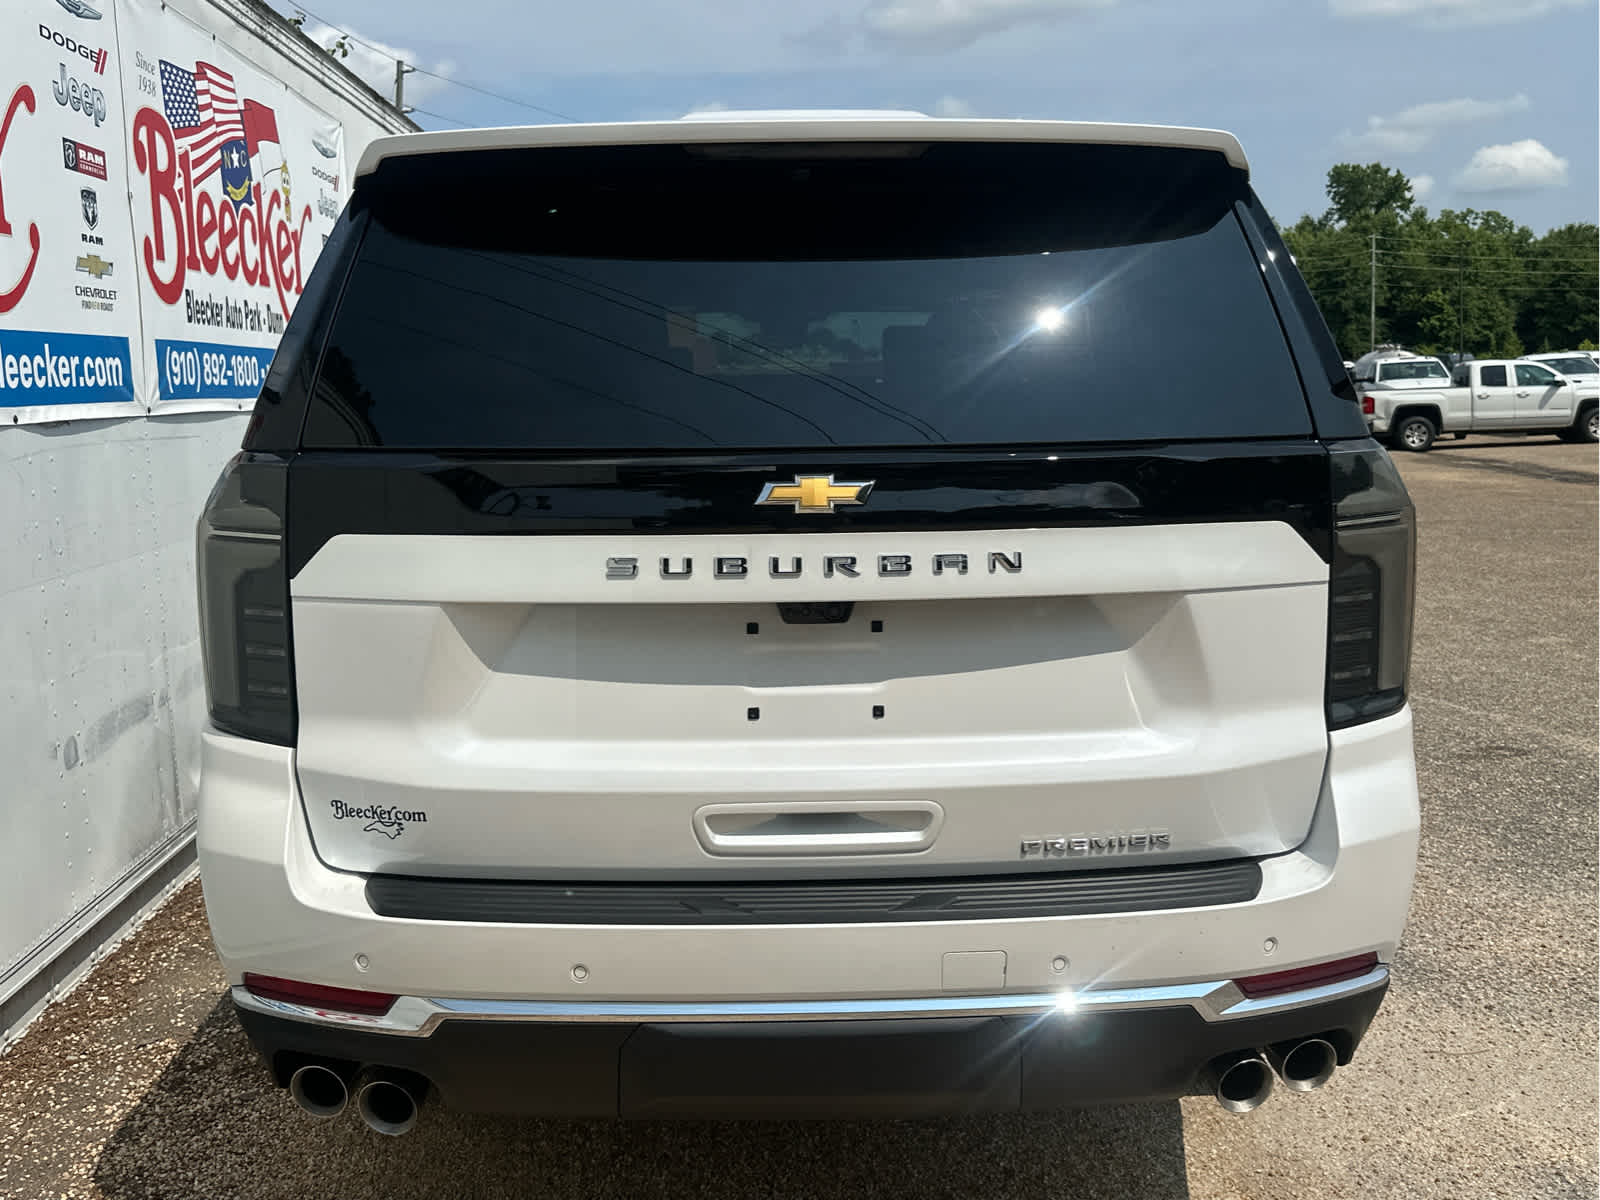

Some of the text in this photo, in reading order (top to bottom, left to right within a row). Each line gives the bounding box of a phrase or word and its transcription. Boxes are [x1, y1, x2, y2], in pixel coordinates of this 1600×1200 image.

[39, 24, 100, 64] DODGE
[136, 51, 156, 75] Since
[52, 62, 106, 127] Jeep
[138, 75, 157, 97] 1938
[79, 149, 104, 166] RAM
[132, 107, 312, 323] Bleecker
[81, 233, 103, 246] RAM
[75, 285, 117, 300] CHEVROLET
[185, 289, 223, 328] Bleecker
[225, 295, 243, 331] Auto
[243, 299, 263, 332] Park
[166, 346, 200, 394] (910)
[202, 353, 259, 387] 892-1800
[605, 551, 1023, 581] SUBURBAN
[1020, 832, 1171, 858] PREMIER
